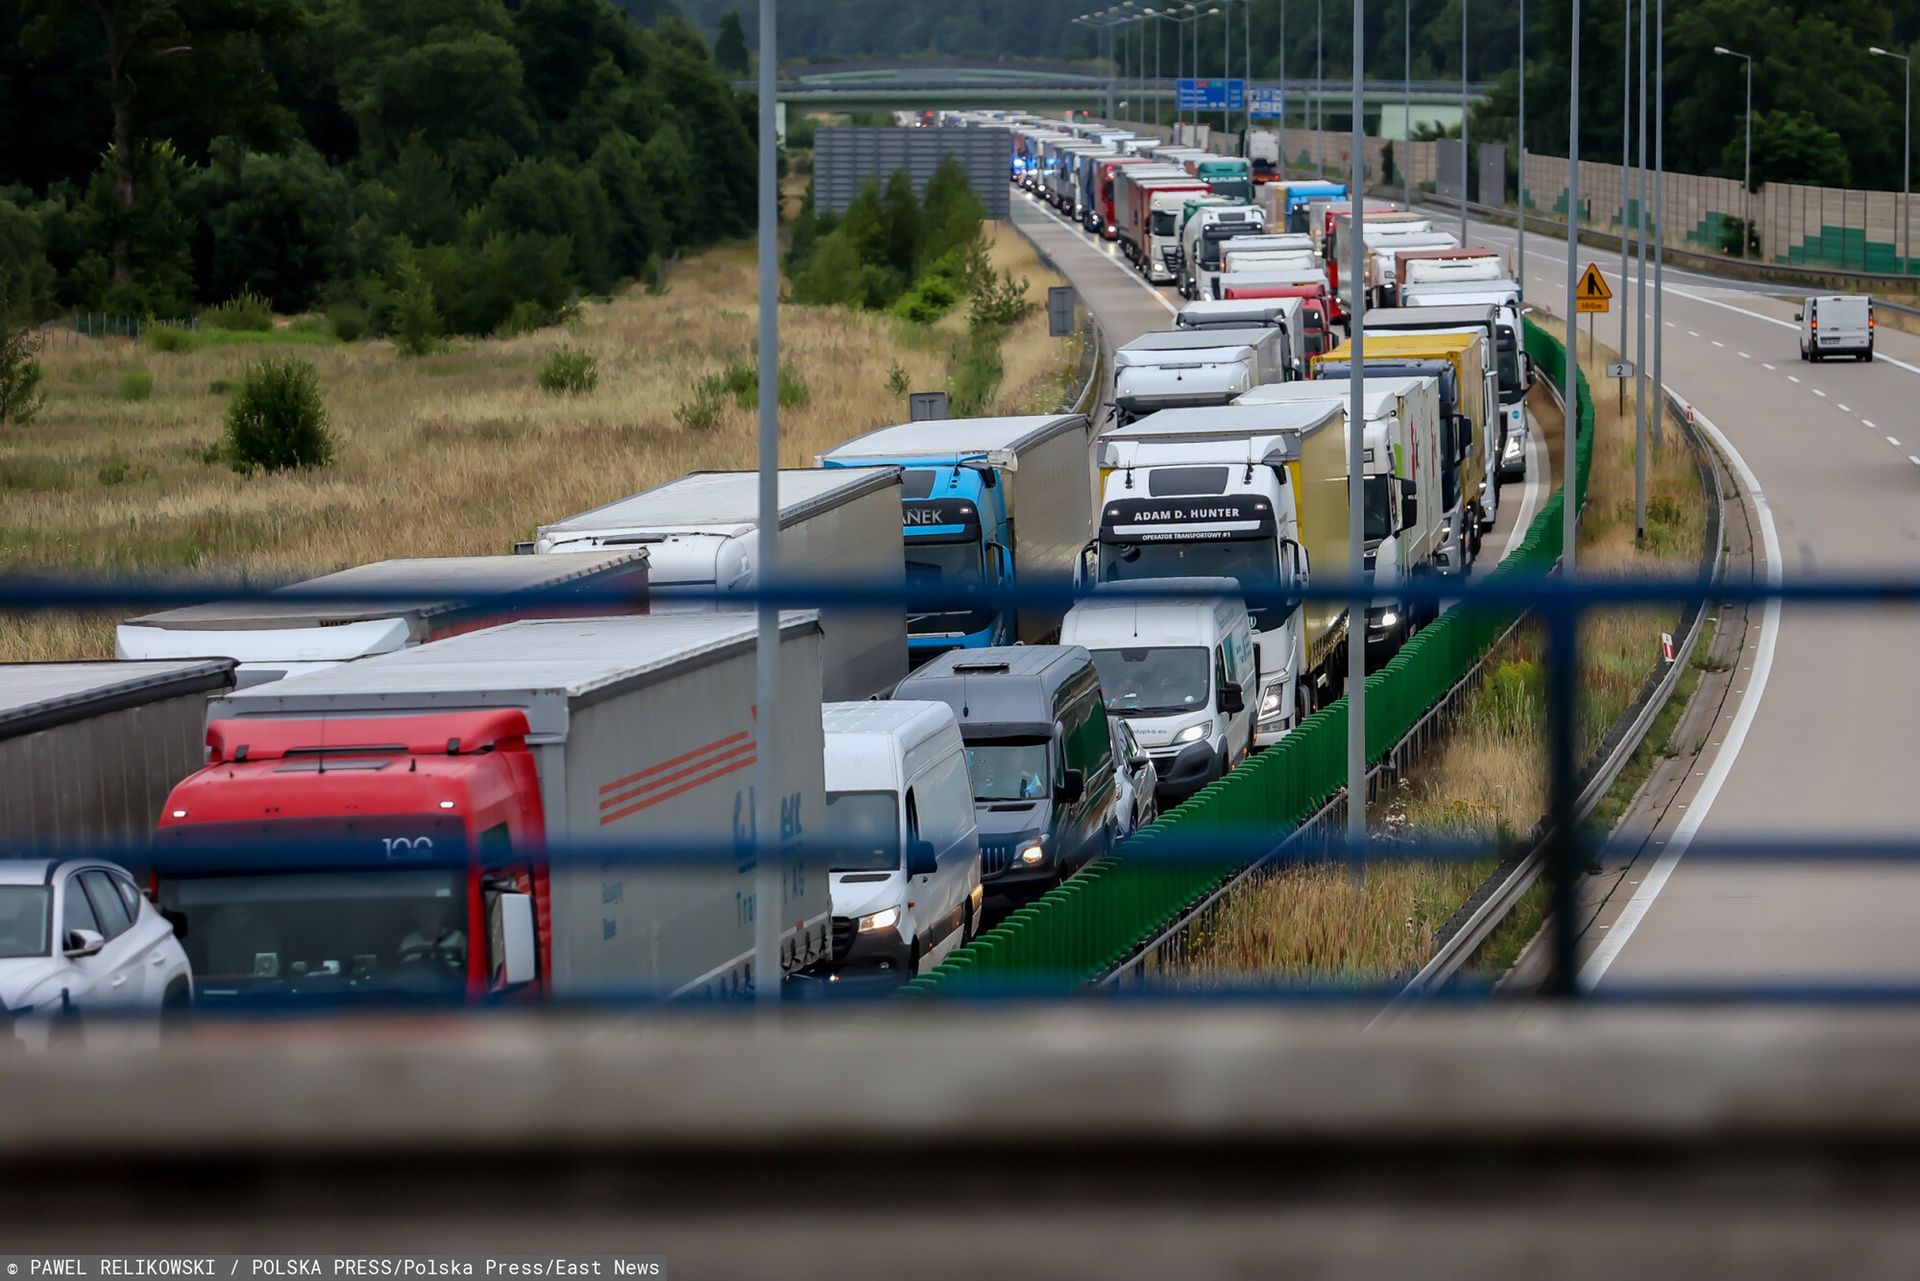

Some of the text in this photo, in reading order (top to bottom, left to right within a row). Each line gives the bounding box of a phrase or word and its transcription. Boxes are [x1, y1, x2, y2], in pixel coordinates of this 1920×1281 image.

[1616, 365, 1623, 375] 2
[902, 509, 943, 524] NEK
[1134, 508, 1239, 521] ADAM D. HUNTER
